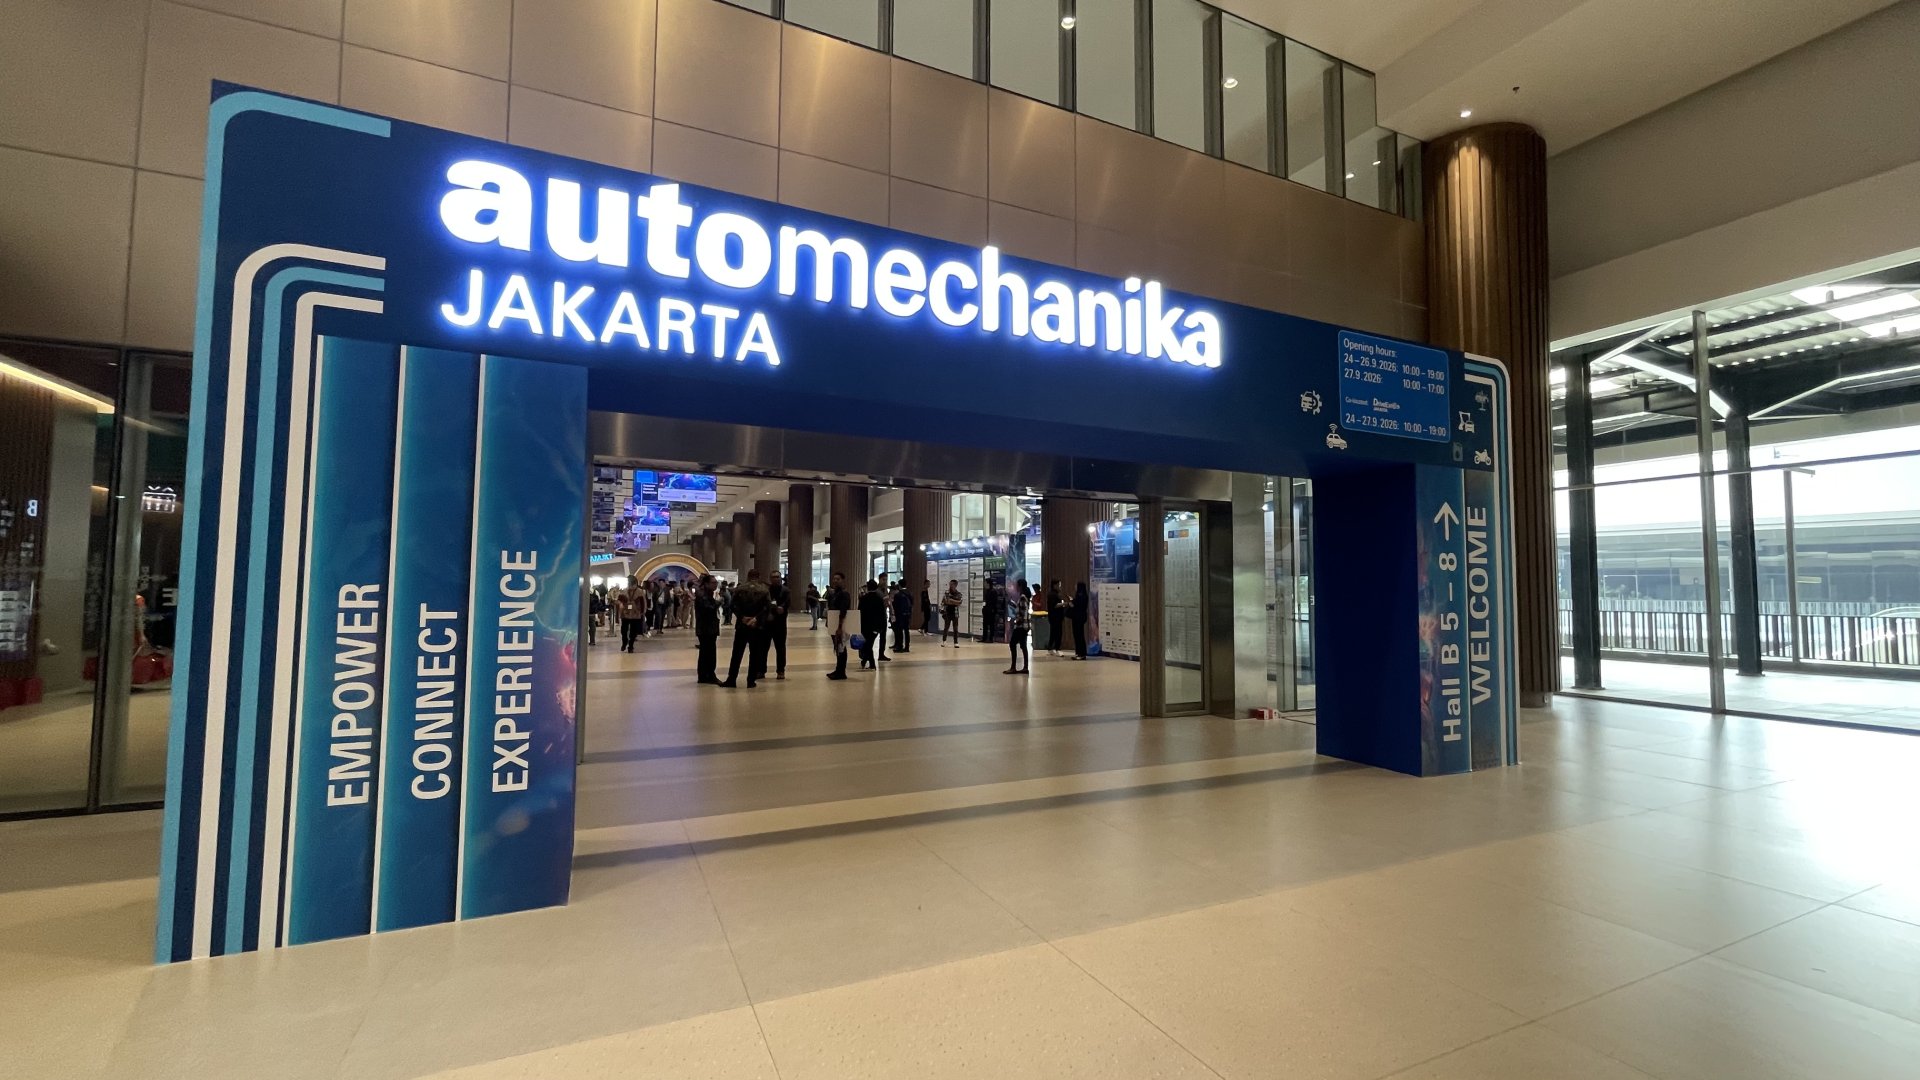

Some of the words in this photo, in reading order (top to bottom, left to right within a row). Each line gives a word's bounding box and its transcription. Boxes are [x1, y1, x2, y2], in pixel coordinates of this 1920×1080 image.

[440, 160, 1221, 369] automechanika
[441, 269, 782, 366] JAKARTA
[1344, 338, 1374, 355] Opening
[1344, 353, 1353, 364] 24
[1402, 364, 1420, 376] 10:00
[1427, 369, 1445, 380] 19:00
[1403, 379, 1420, 391] 10:00
[1428, 384, 1445, 395] 17:00
[1346, 413, 1355, 424] 24
[1404, 422, 1421, 433] 10:00
[1429, 426, 1446, 437] 19:00
[1439, 552, 1457, 572] 8
[1440, 612, 1460, 631] 5
[1466, 506, 1492, 706] WELCOME
[492, 550, 538, 793] EXPERIENCE
[1441, 644, 1460, 665] B
[327, 583, 381, 807] EMPOWER
[412, 603, 458, 801] CONNECT
[1442, 678, 1461, 742] Hall
